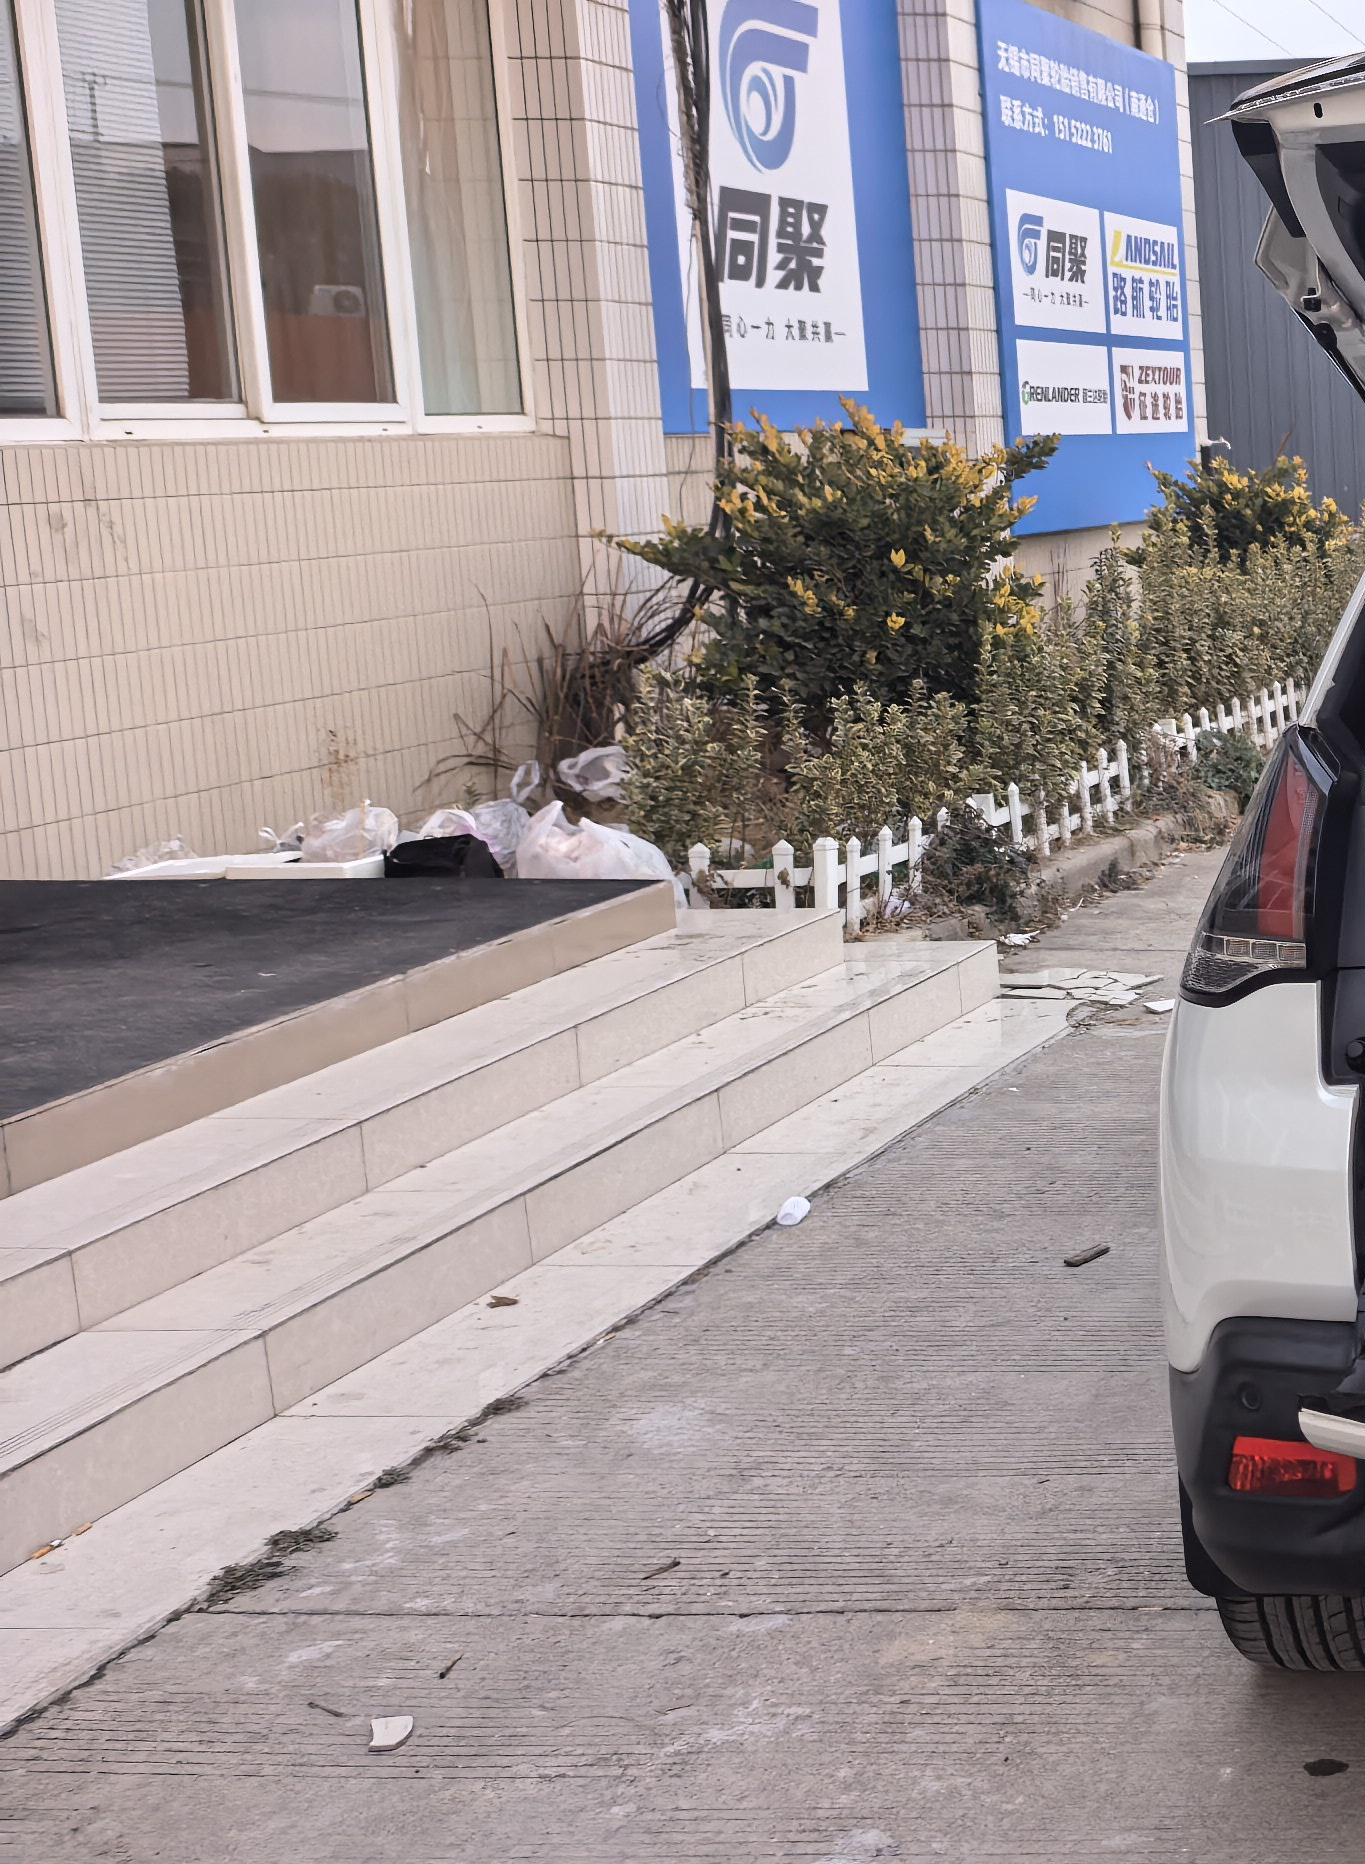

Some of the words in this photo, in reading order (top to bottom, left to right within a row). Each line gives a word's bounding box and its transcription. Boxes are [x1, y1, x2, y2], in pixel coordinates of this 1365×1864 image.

[1053, 114, 1070, 141] 151
[715, 185, 828, 293] 同聚
[1045, 229, 1088, 284] 同聚
[1110, 229, 1178, 277] LANDSAIL
[1112, 272, 1179, 323] 路航轮胎
[1022, 380, 1080, 405] GRENLANDER
[1138, 365, 1182, 386] ZEXTOUR
[1138, 391, 1184, 421] 征途轮胎
